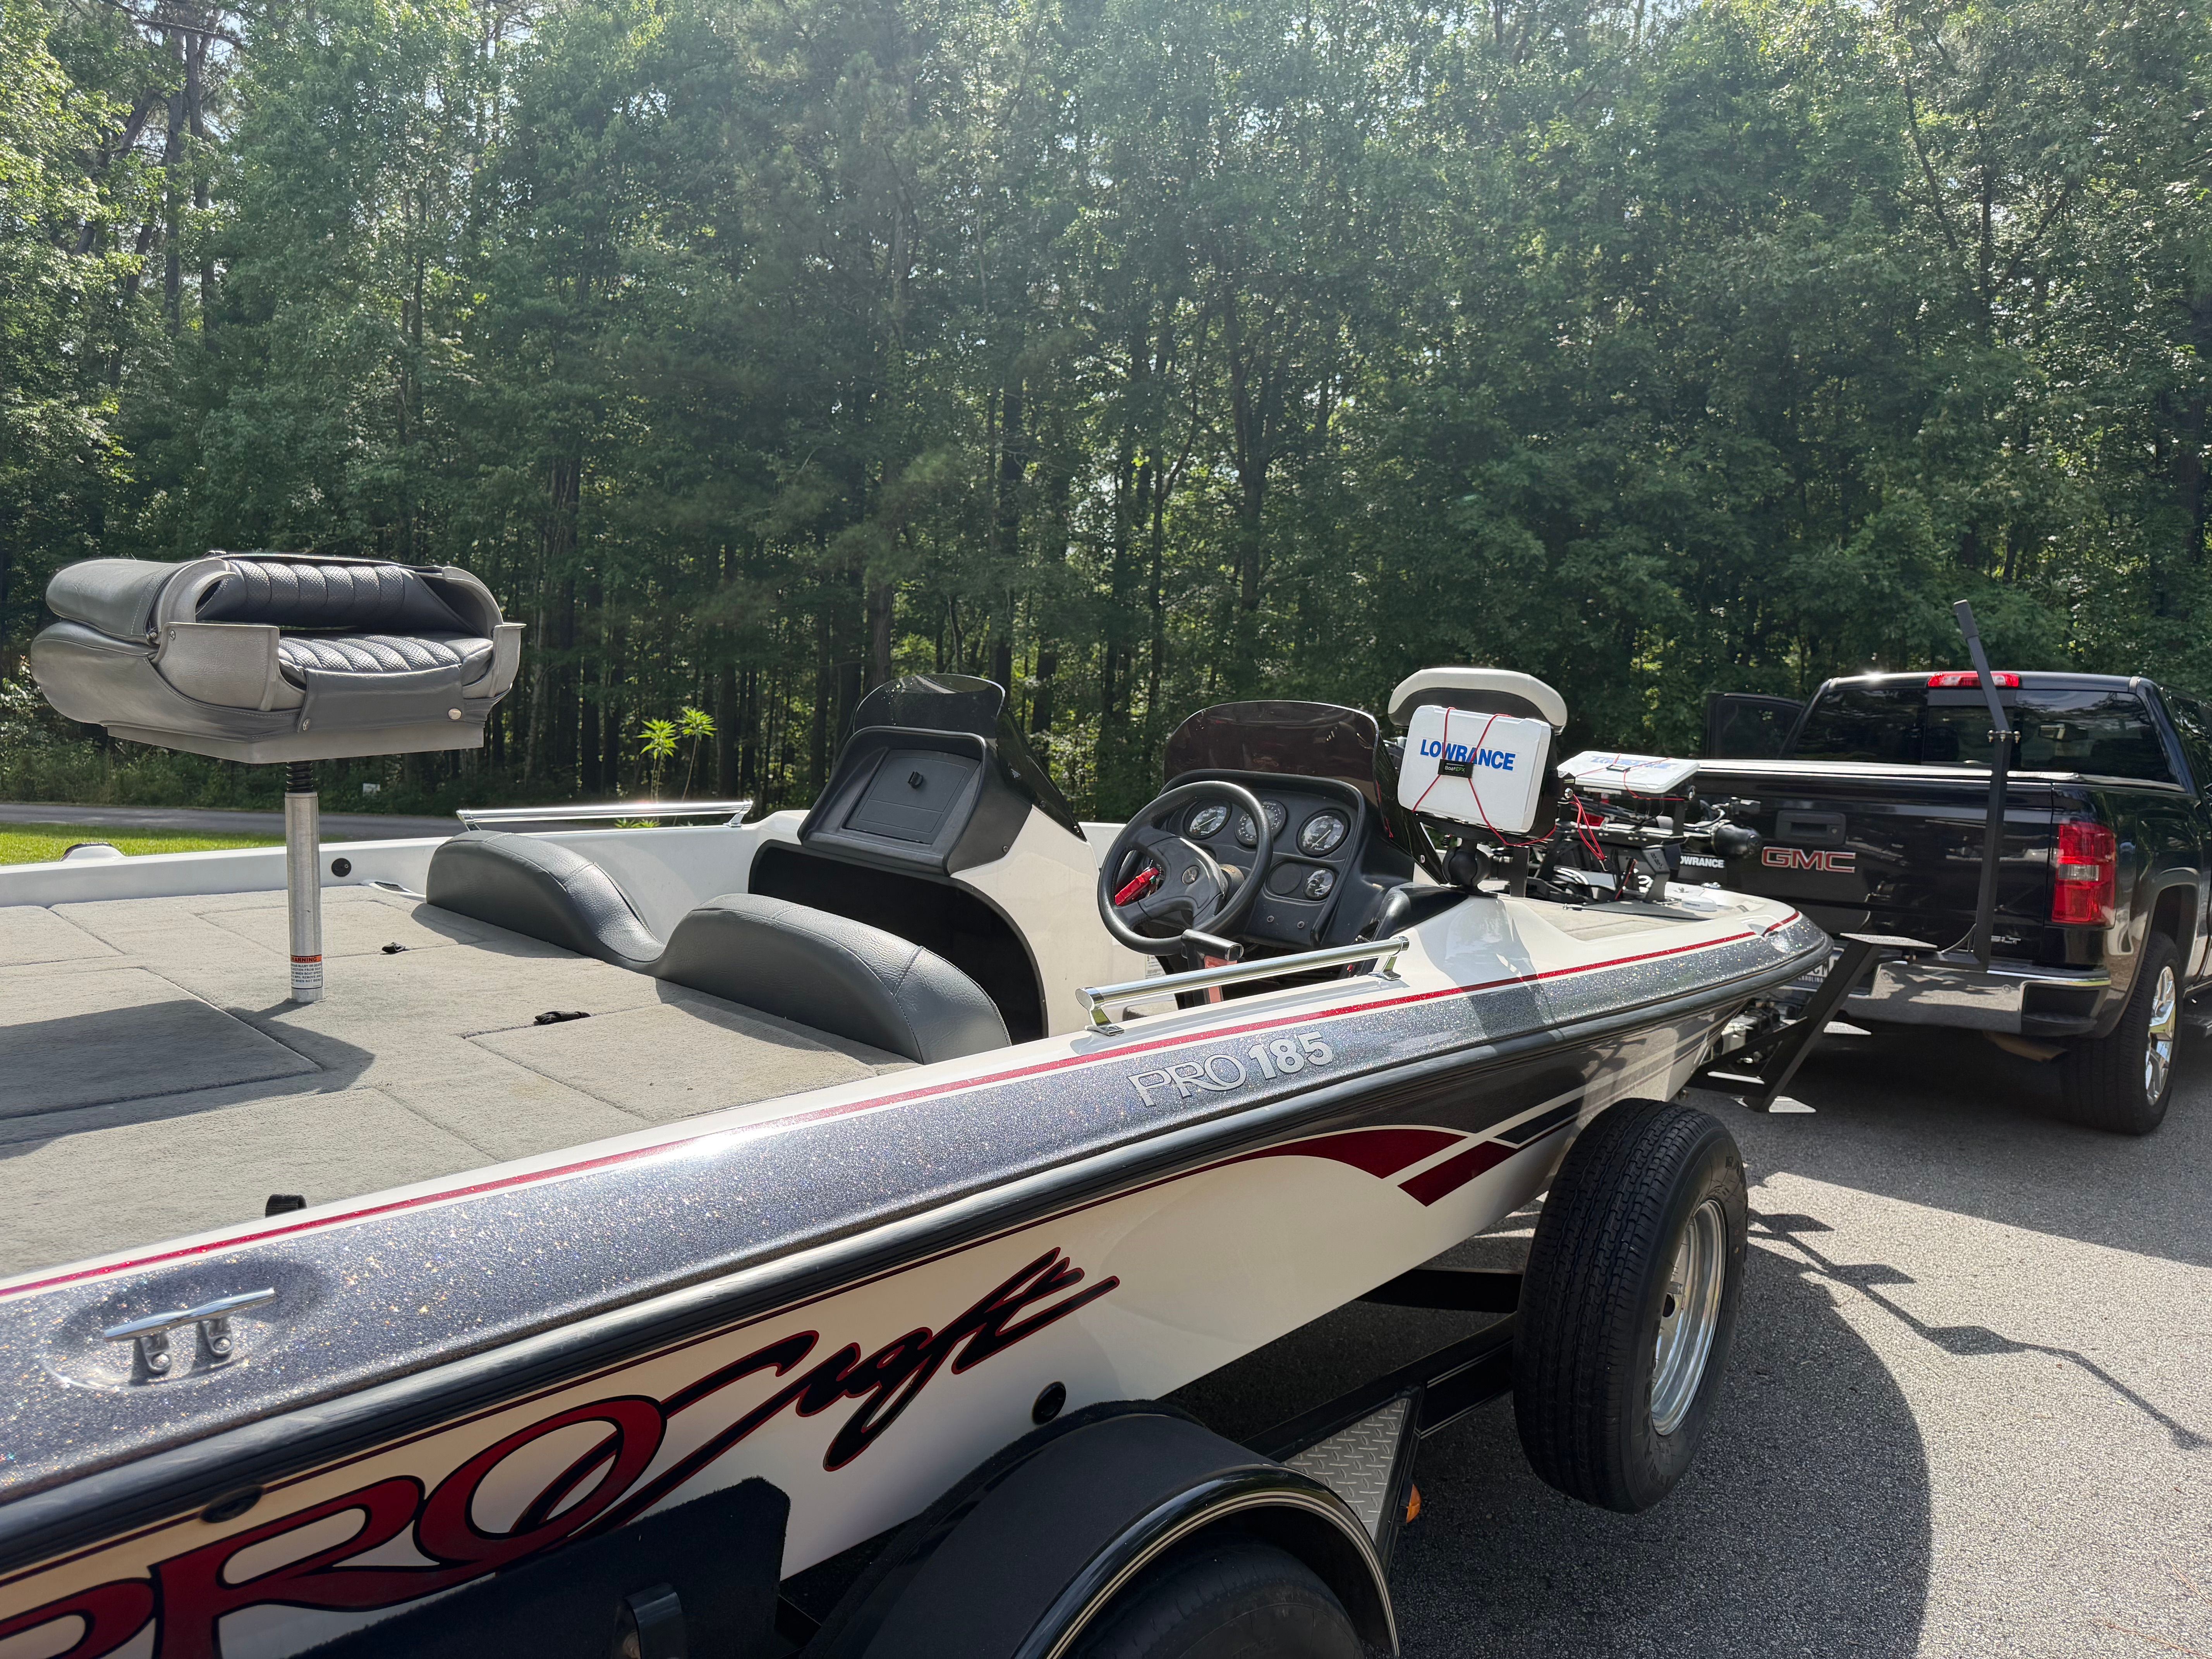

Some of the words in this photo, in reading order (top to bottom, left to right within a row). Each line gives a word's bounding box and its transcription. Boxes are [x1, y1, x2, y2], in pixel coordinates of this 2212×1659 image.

[1420, 738, 1516, 771] LOWRANCE
[1680, 855, 1724, 869] OWRANCE
[1762, 846, 1856, 874] GMC
[1127, 1053, 1247, 1108] PRO
[1247, 1030, 1334, 1080] 185
